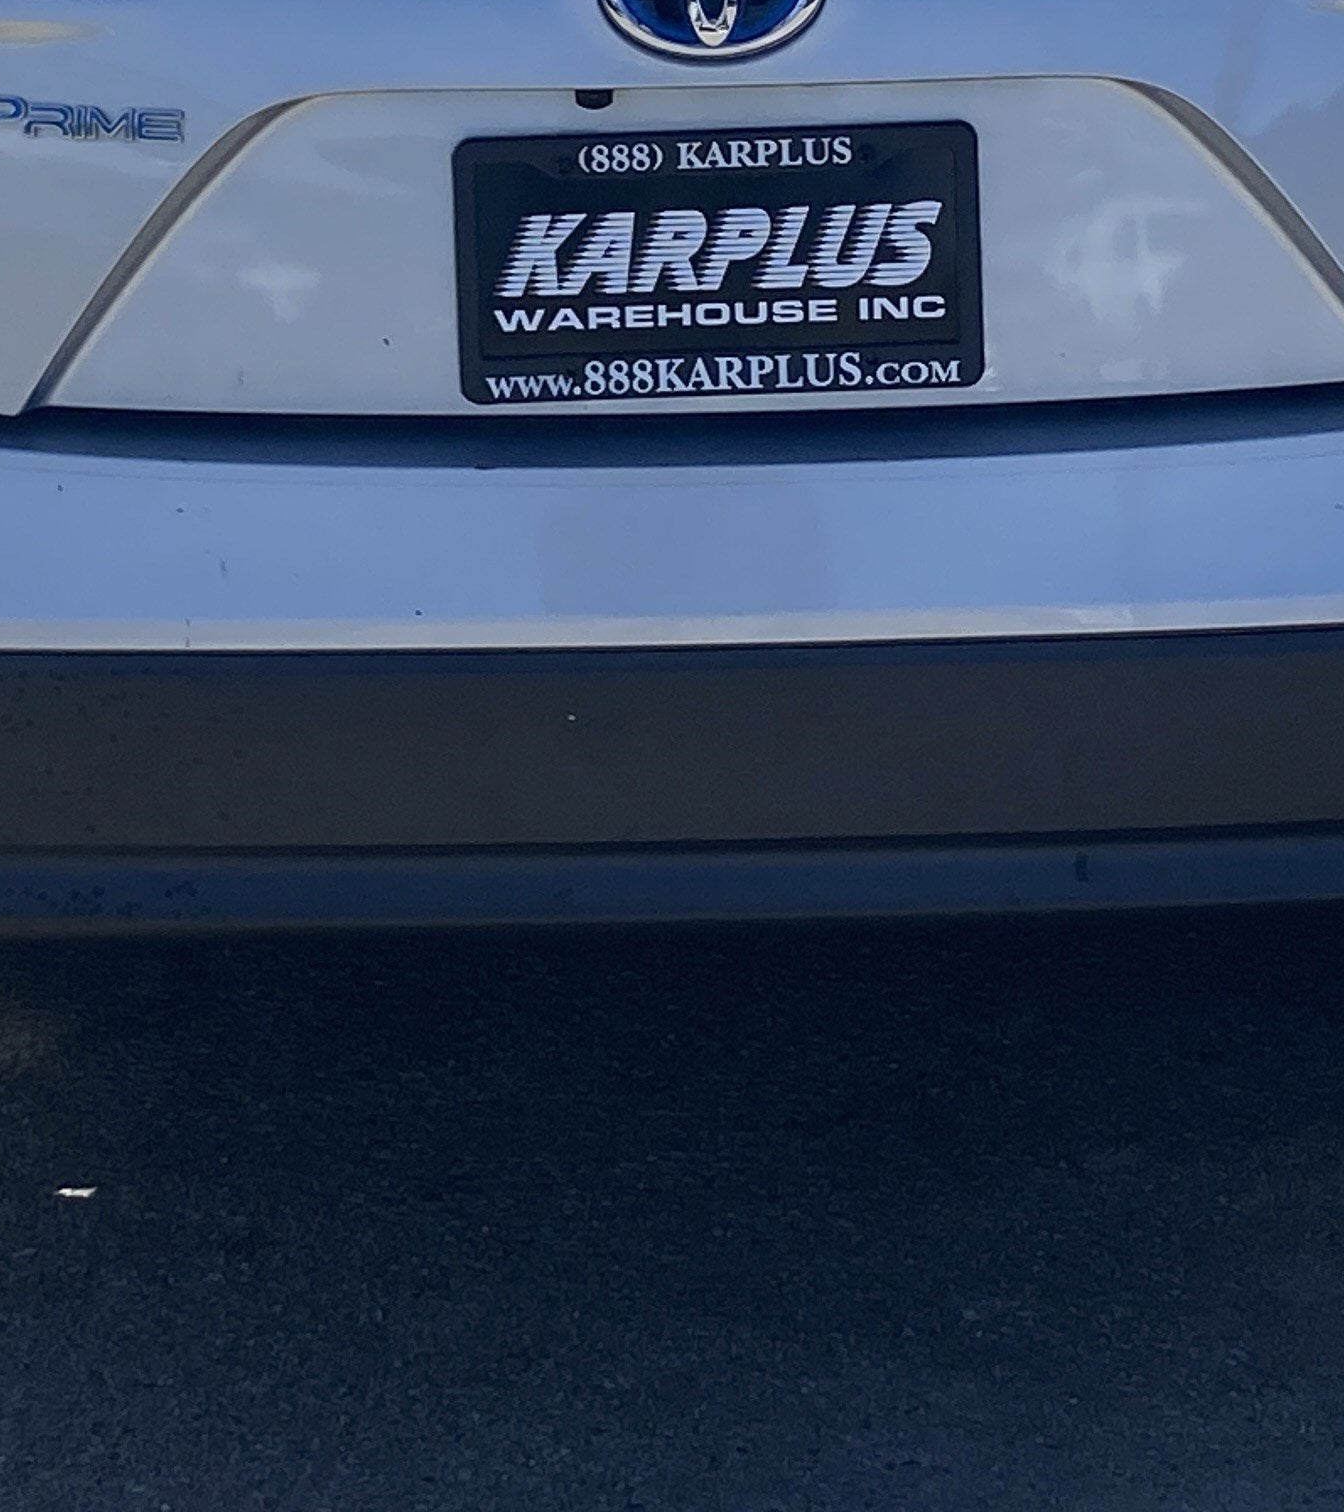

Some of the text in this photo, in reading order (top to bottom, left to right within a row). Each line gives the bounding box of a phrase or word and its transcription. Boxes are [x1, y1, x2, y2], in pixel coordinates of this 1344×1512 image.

[577, 136, 853, 174] (888) KARPLUS
[492, 199, 943, 298] KARPLUS
[493, 295, 947, 333] WAREHOUSE INC
